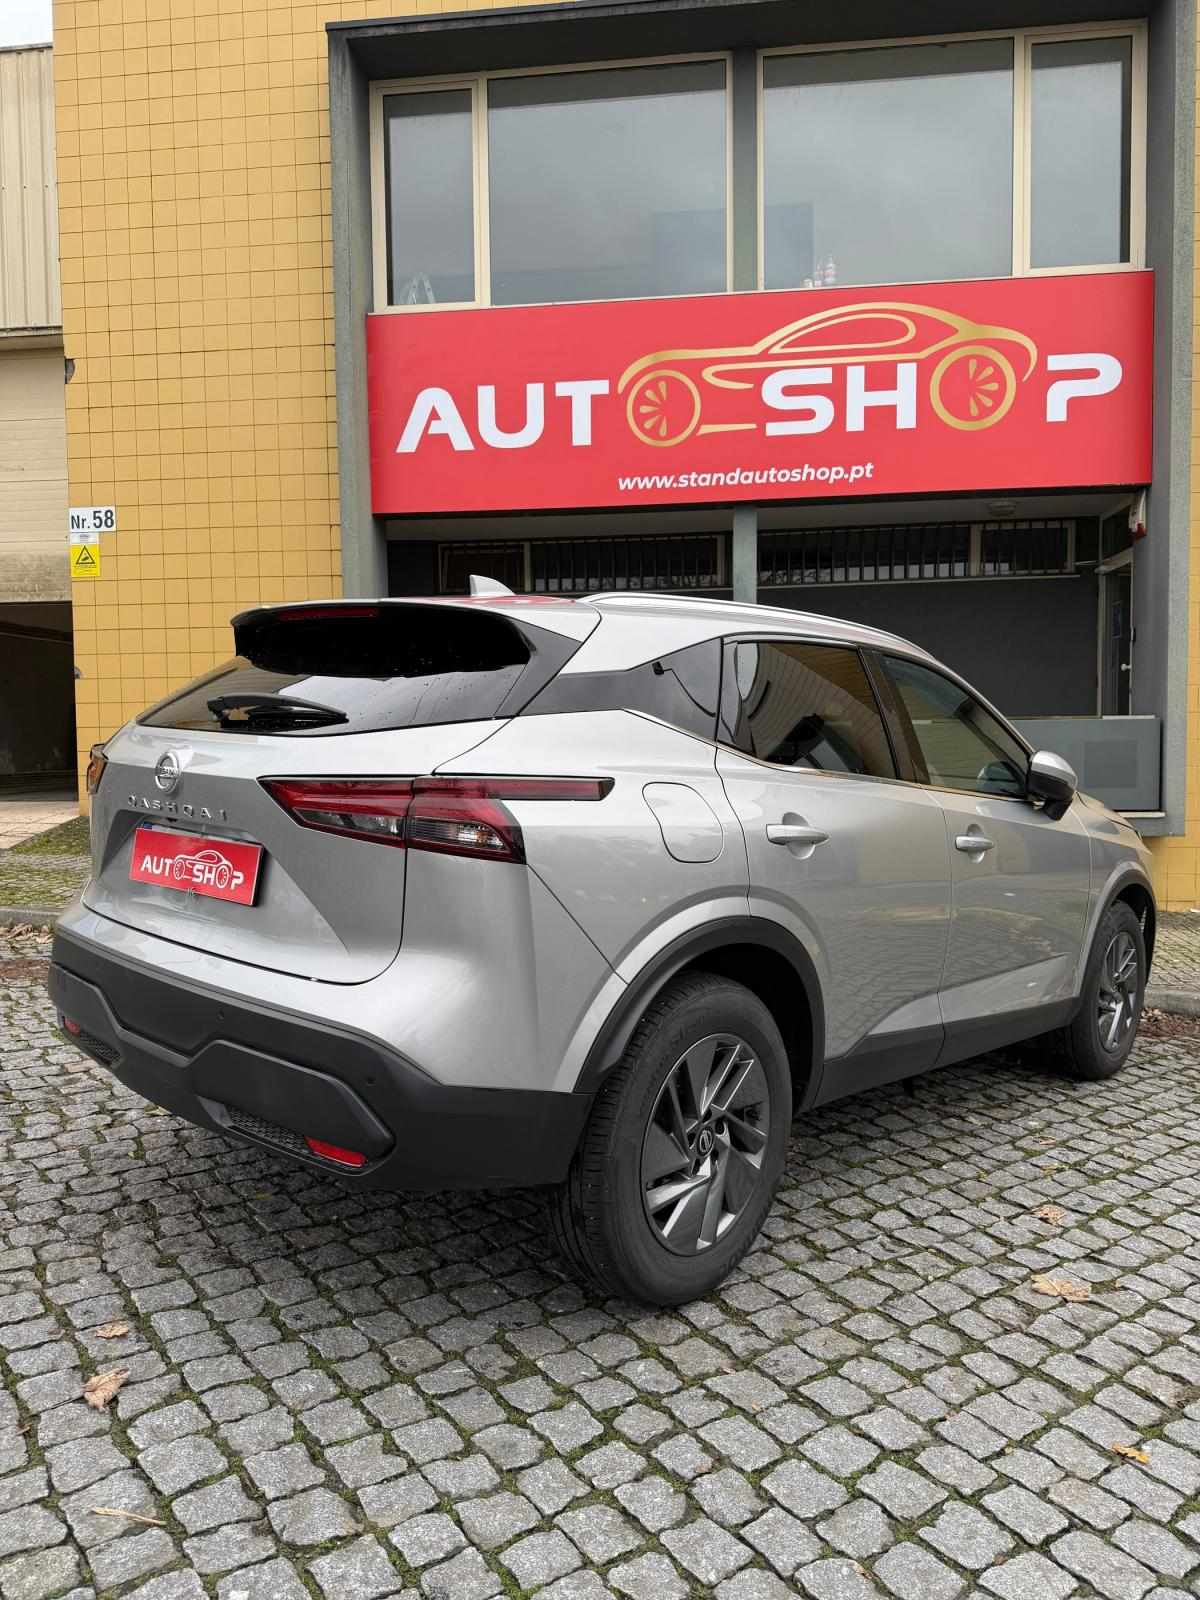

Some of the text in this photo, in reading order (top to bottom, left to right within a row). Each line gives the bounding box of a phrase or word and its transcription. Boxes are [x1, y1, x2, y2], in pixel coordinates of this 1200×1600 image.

[618, 462, 875, 492] www.standautoshop.pt
[92, 509, 115, 529] 58
[127, 794, 228, 820] QASHQAI
